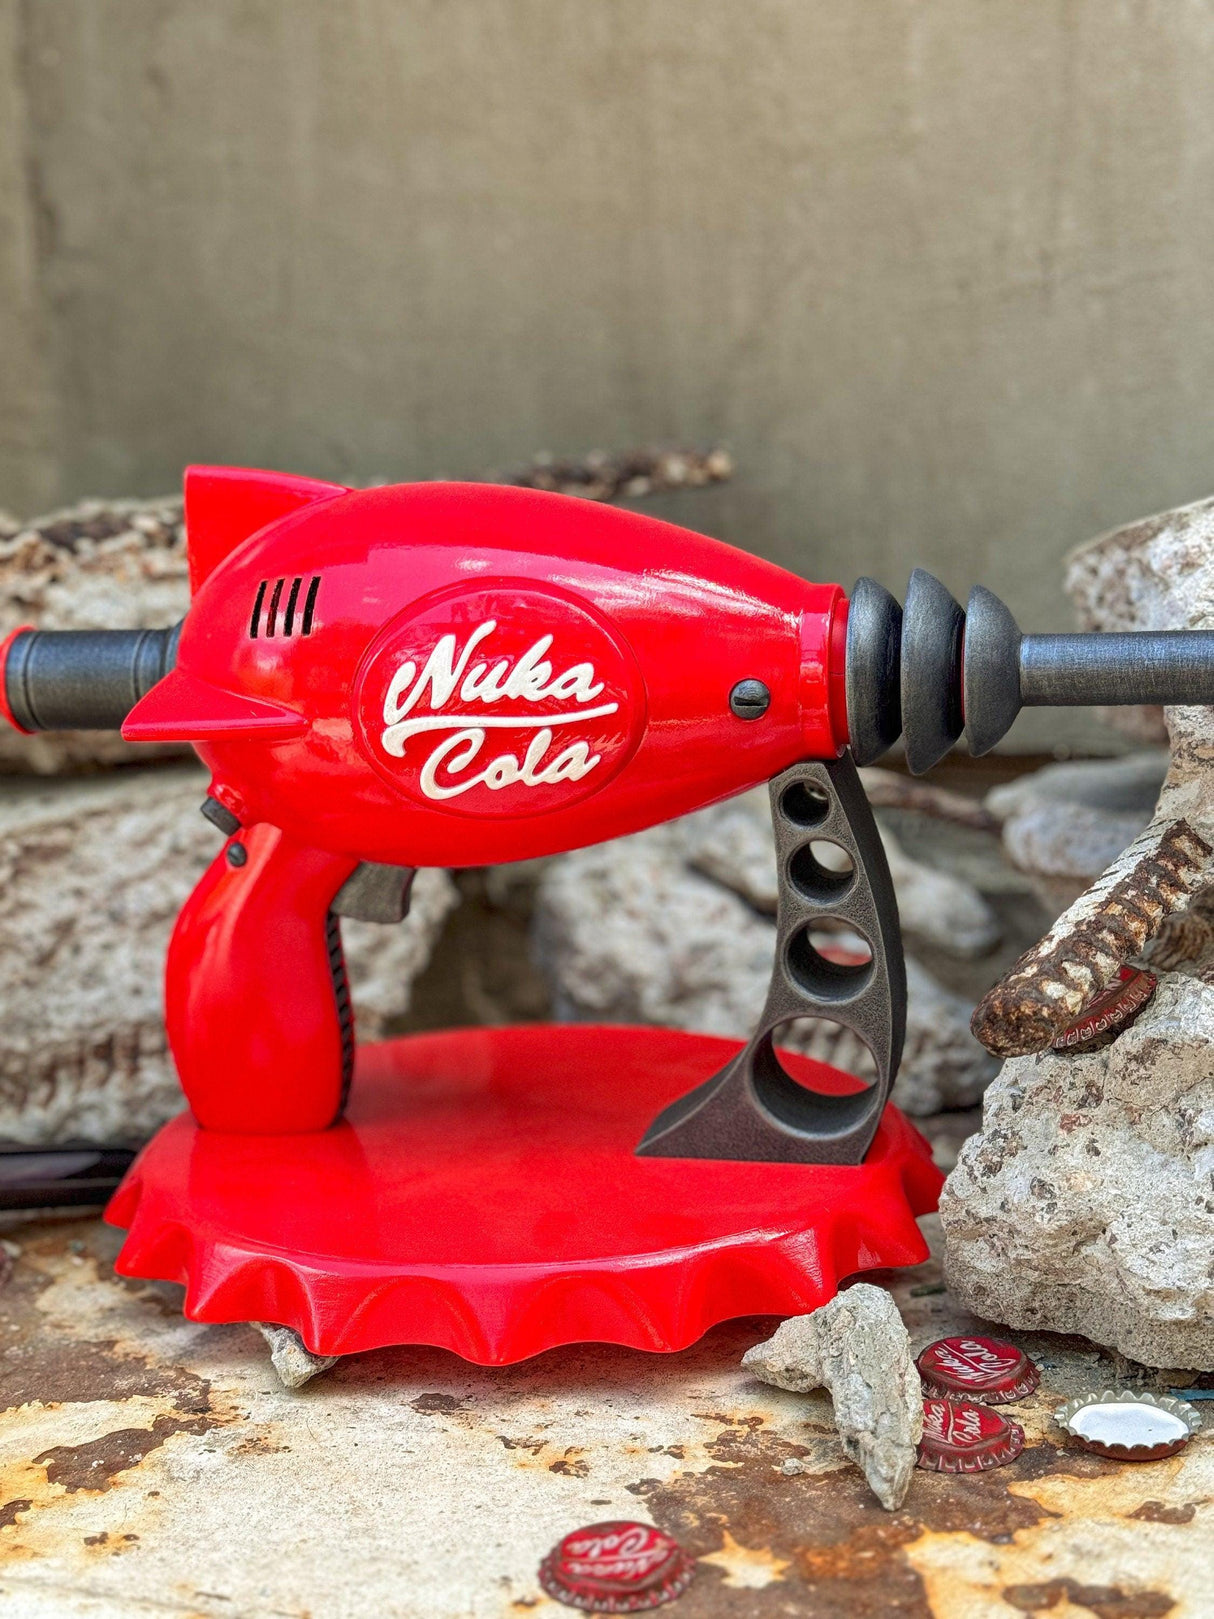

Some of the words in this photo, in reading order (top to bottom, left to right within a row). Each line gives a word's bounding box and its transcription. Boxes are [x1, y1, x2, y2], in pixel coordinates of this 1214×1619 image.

[383, 620, 604, 725] Nuka
[420, 728, 600, 800] Cola
[935, 1346, 1002, 1383] Nuka
[960, 1340, 1016, 1368] Cola
[566, 1527, 649, 1557] Cola
